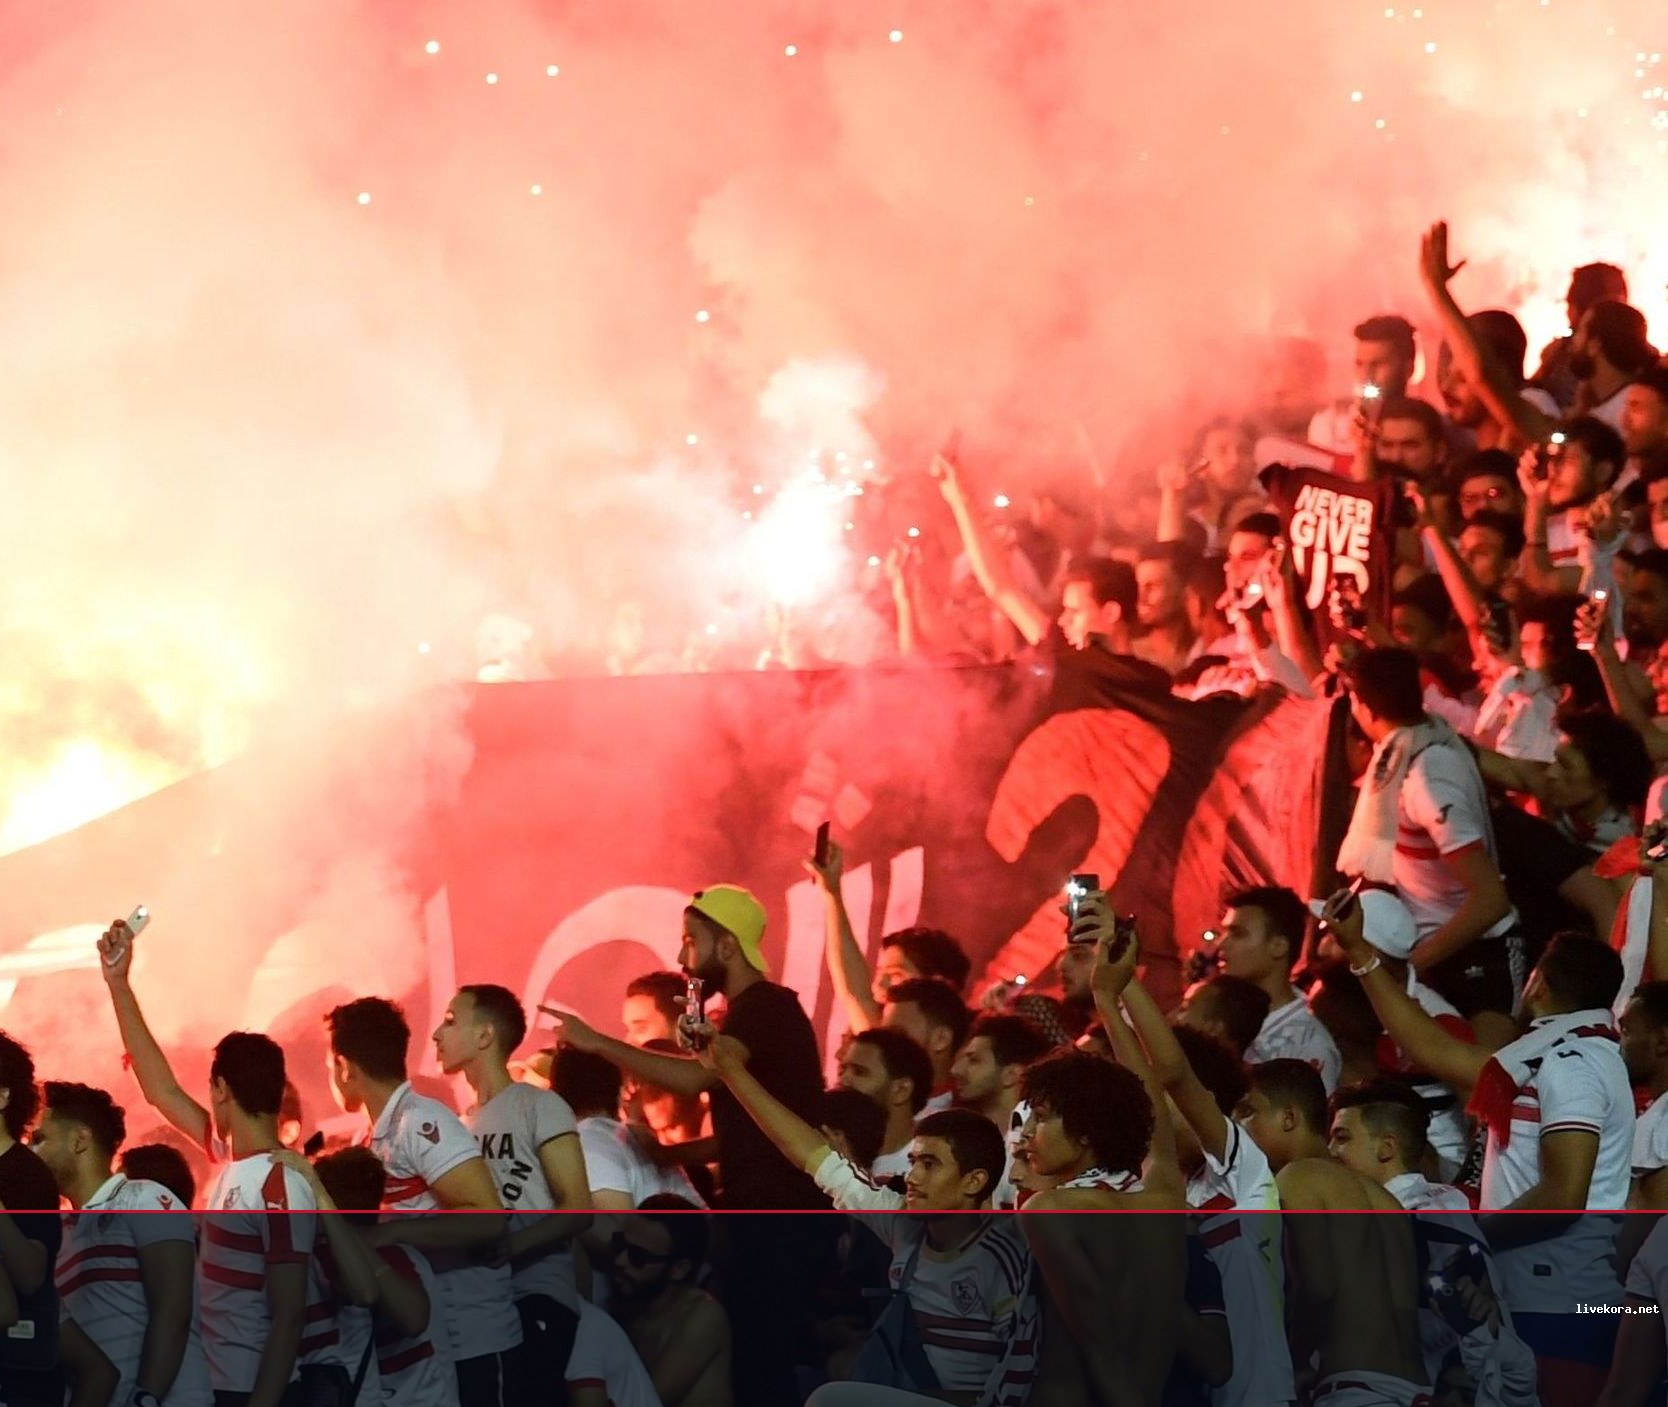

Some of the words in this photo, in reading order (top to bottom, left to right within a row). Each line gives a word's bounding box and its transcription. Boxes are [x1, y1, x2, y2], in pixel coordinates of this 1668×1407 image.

[1294, 484, 1373, 525] NEVER
[1290, 509, 1371, 561] GIVE
[473, 1132, 515, 1159] KA
